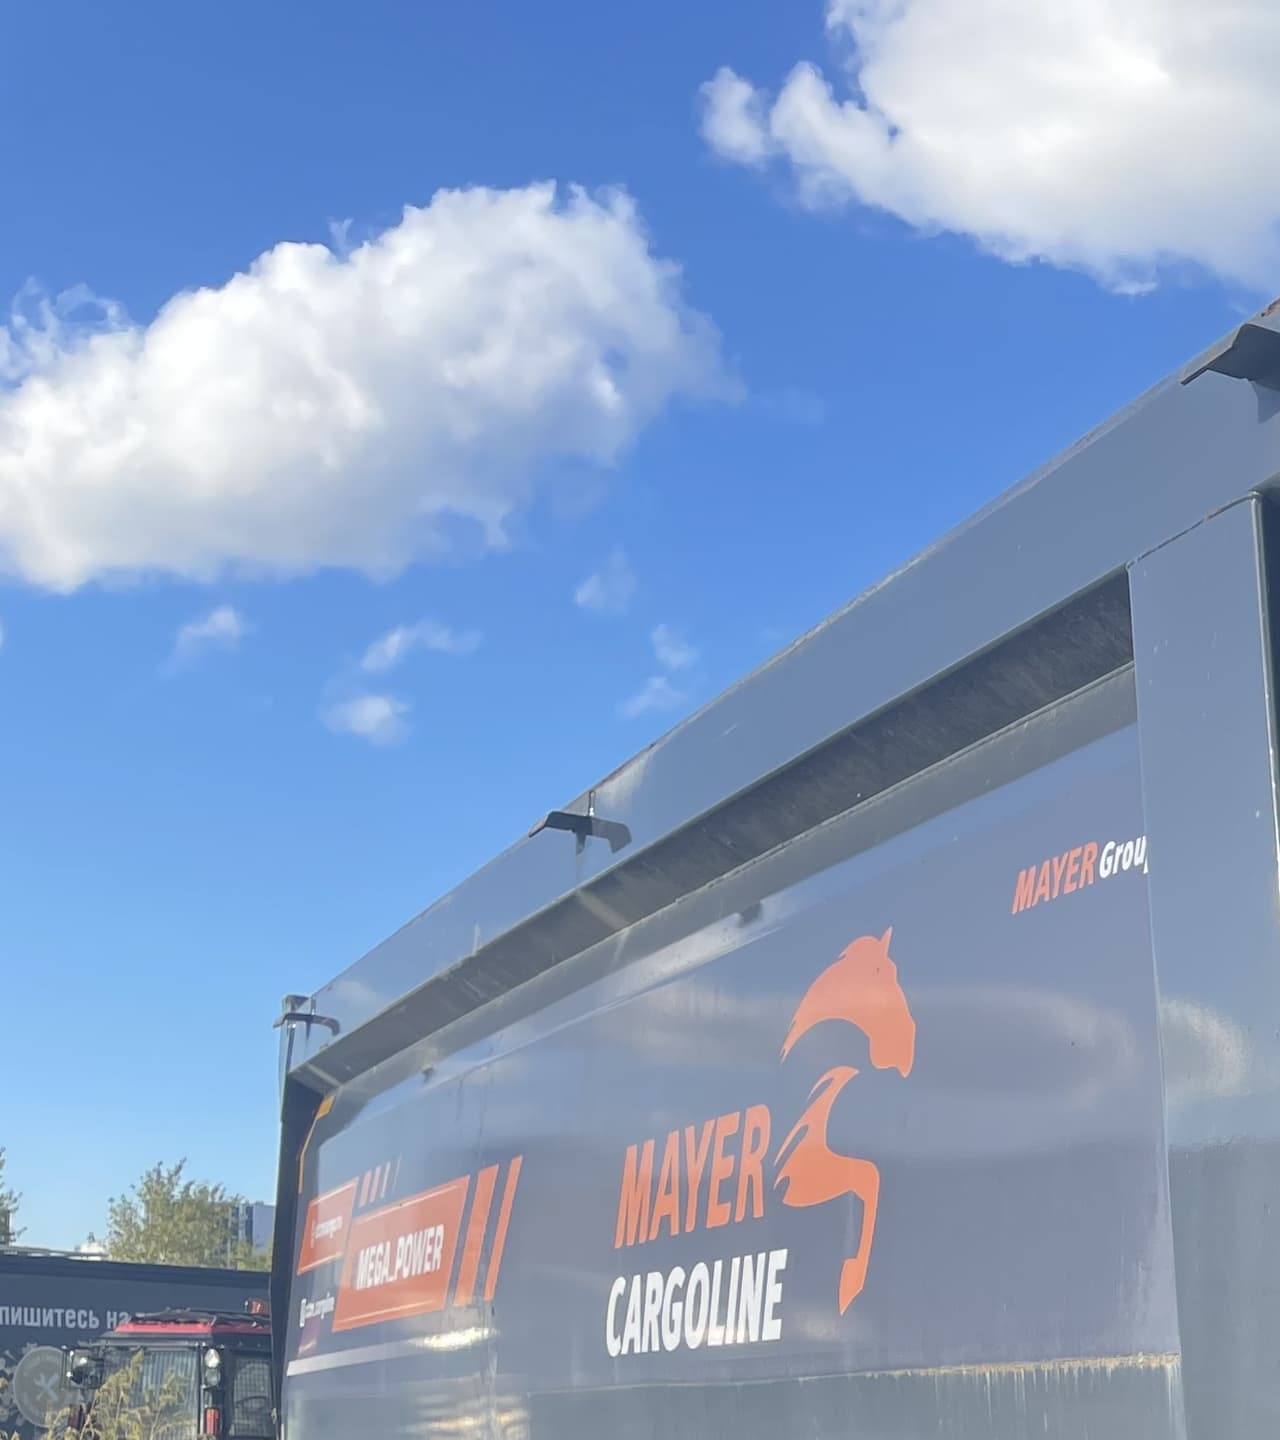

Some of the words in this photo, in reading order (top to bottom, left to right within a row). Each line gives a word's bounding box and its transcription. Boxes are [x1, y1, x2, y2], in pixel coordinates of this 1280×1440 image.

[1012, 841, 1098, 914] MAYER
[1099, 835, 1149, 879] Grou
[614, 1103, 771, 1249] MAYER
[0, 1305, 100, 1329] пишитесь
[605, 1248, 788, 1357] CARGOLINE
